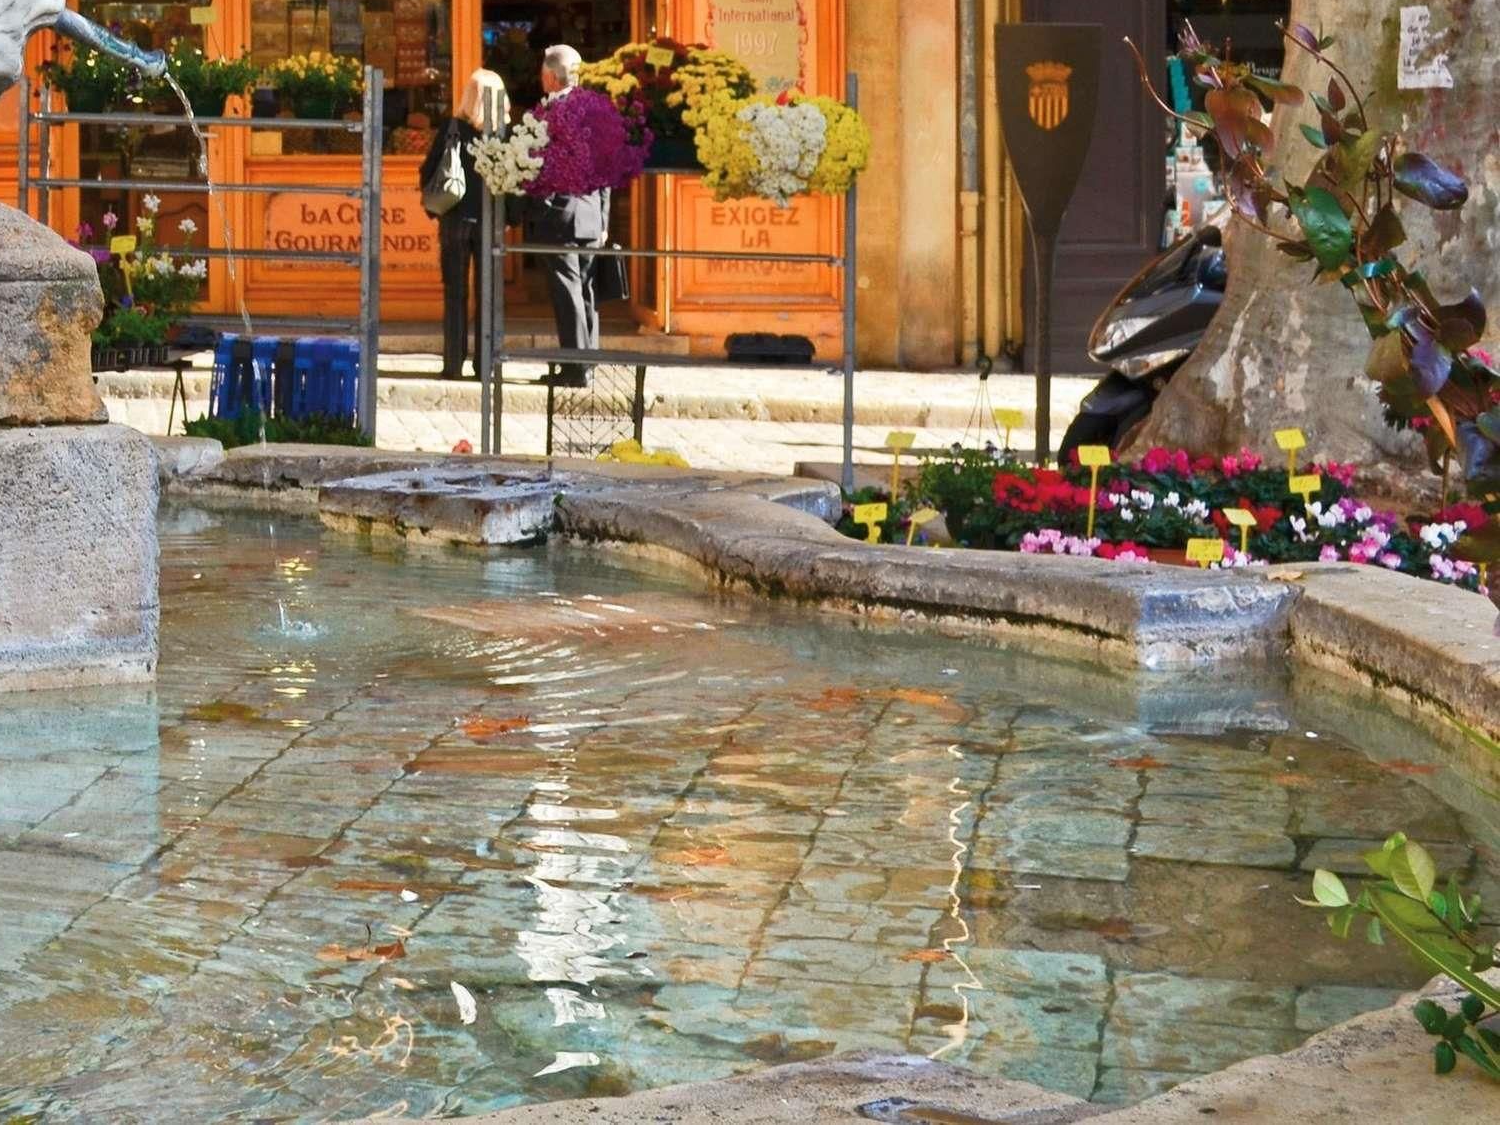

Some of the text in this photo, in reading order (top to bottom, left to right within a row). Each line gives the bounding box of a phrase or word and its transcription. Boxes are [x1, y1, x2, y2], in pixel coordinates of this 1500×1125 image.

[718, 8, 795, 24] International
[301, 203, 332, 224] LA
[710, 206, 800, 226] EXIGEZ
[274, 229, 432, 252] GOURMNDE
[740, 229, 771, 249] LA
